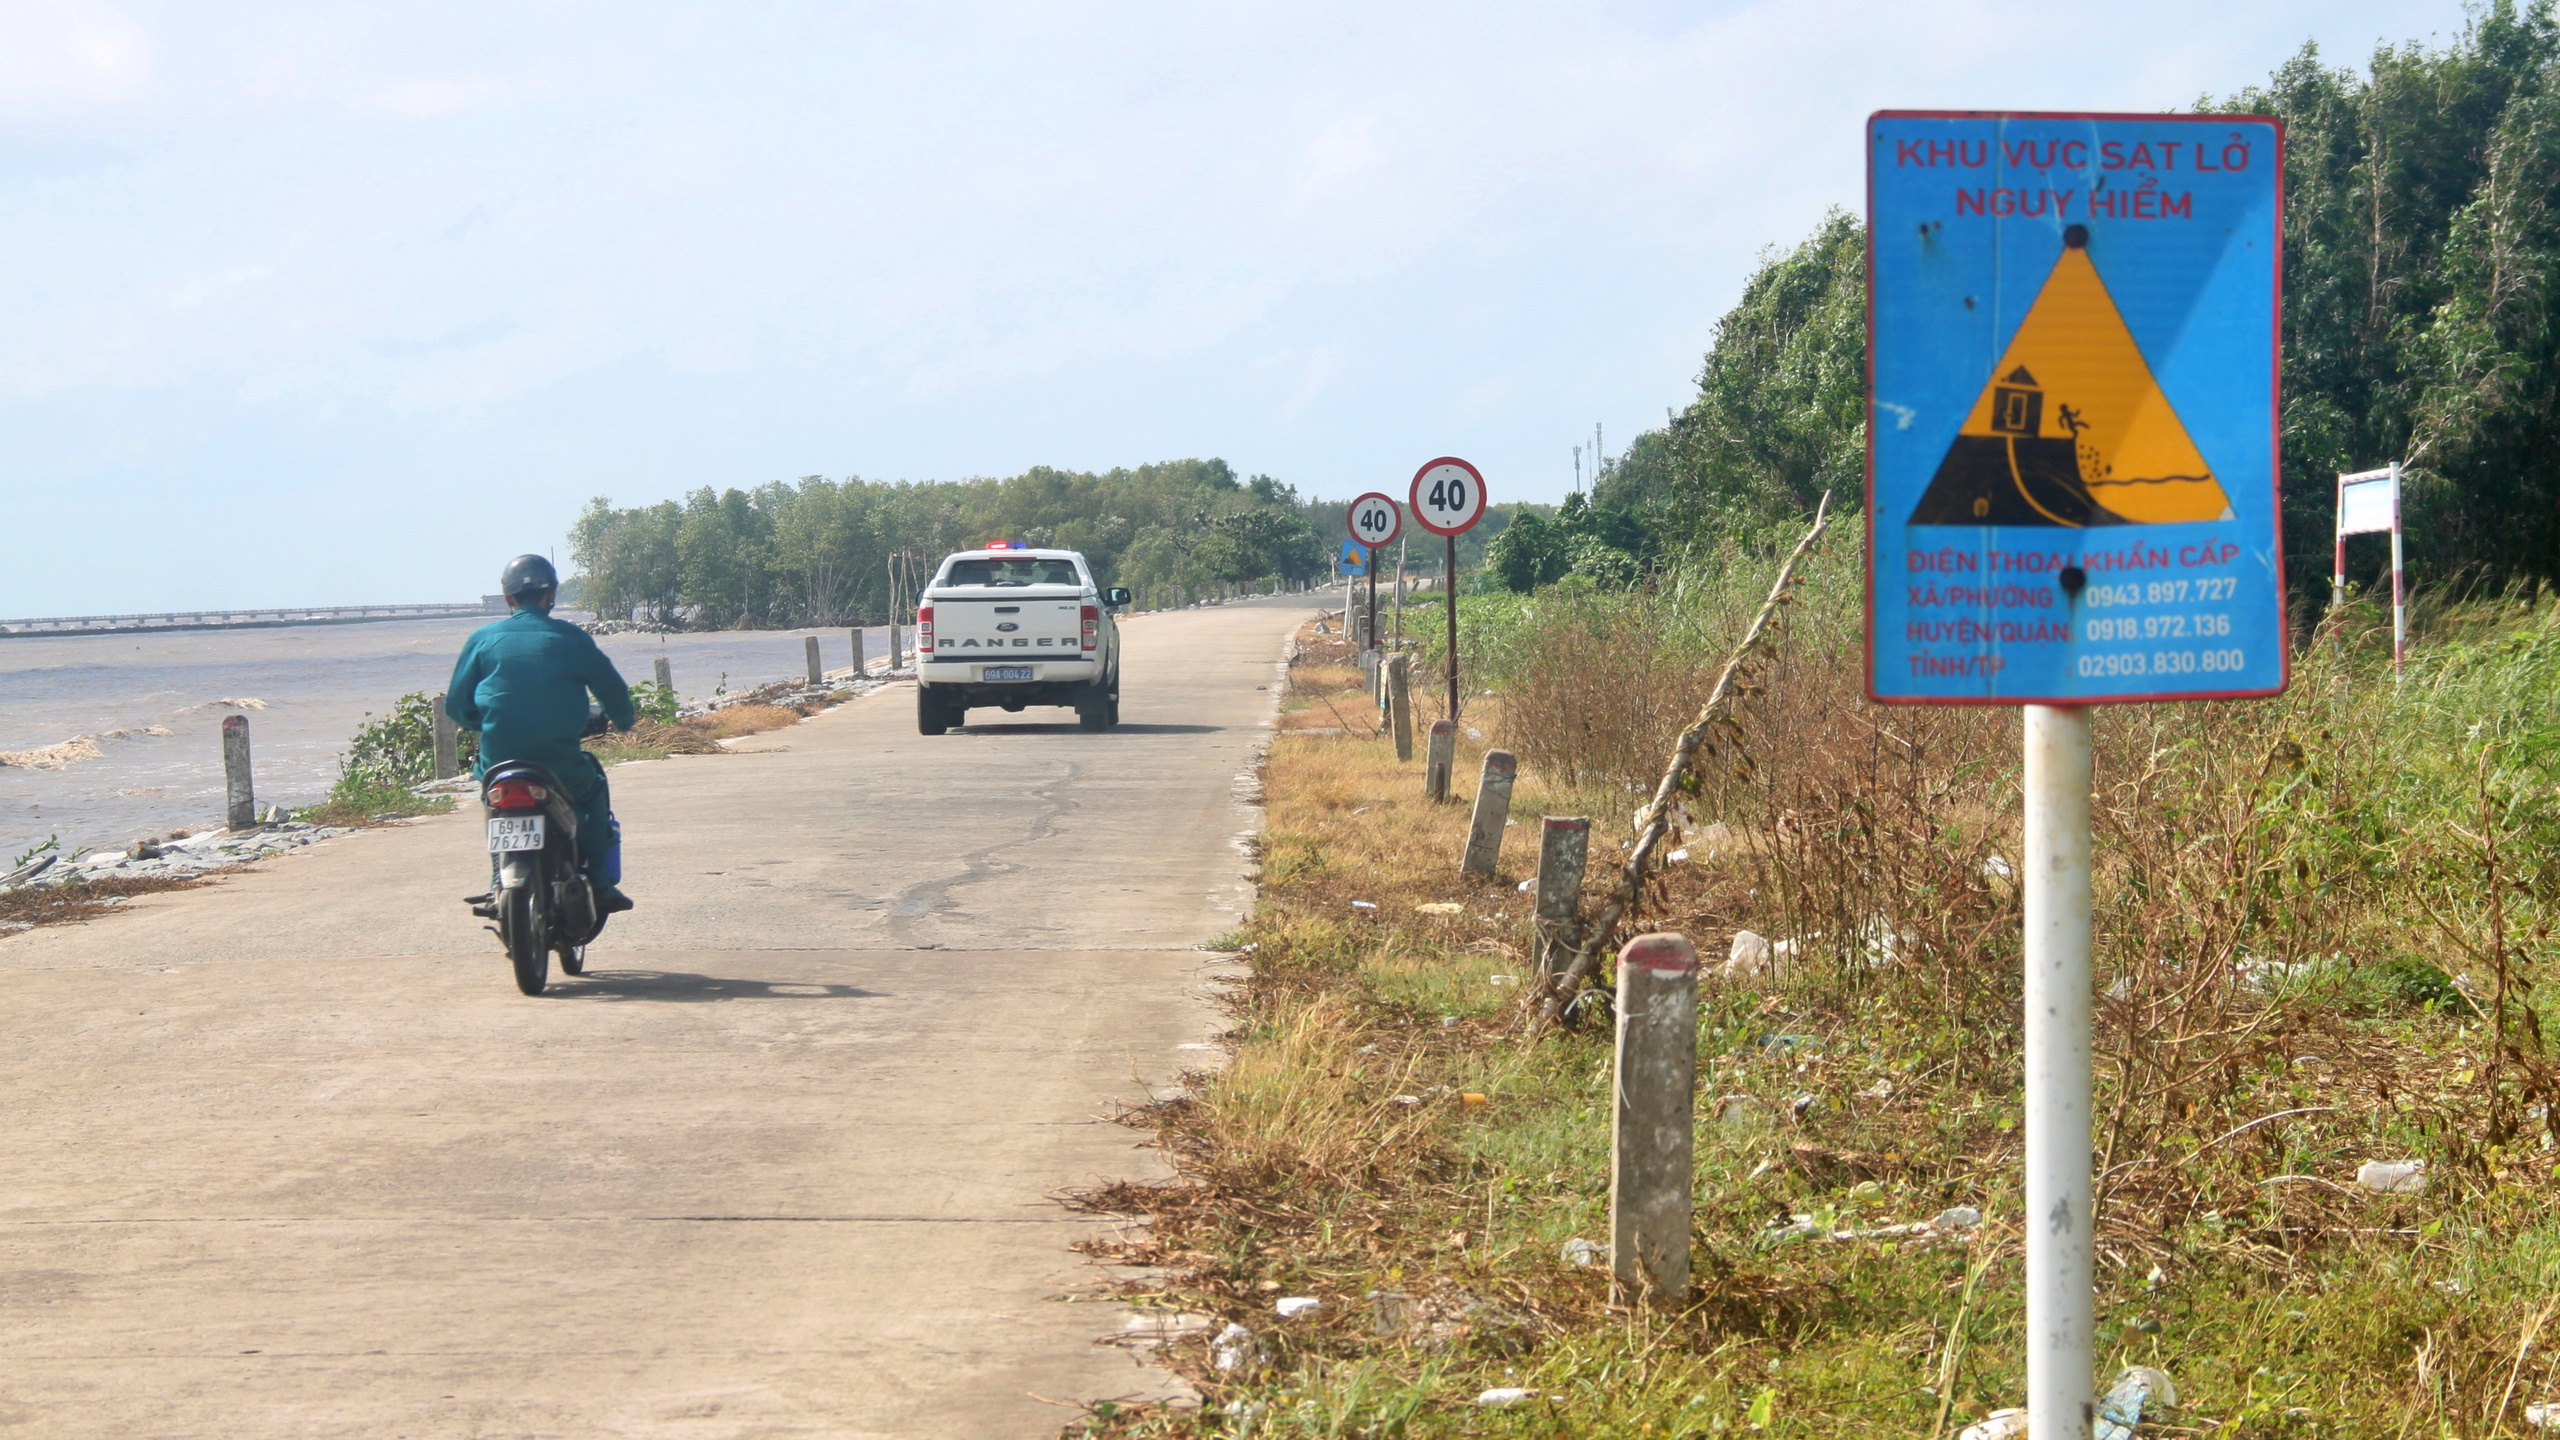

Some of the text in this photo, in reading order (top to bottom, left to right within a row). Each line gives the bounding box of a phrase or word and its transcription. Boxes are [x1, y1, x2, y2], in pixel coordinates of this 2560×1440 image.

[1897, 132, 2251, 178] KHU VỰC SẠT LỞ
[1956, 177, 2191, 219] NGUY HIỂM
[1428, 479, 1466, 512] 40
[1360, 509, 1387, 533] 40
[1908, 546, 1977, 577] ĐIỆN
[1988, 551, 2073, 579] THOẠI
[2179, 537, 2240, 568] CẤP
[2086, 577, 2237, 608] 0943.897.727
[2087, 614, 2231, 641] 0918.972.136
[938, 638, 1078, 648] RANGER
[2079, 649, 2244, 678] 02903.830.800
[498, 819, 535, 834] 69-AA
[492, 833, 541, 851] 762.79
